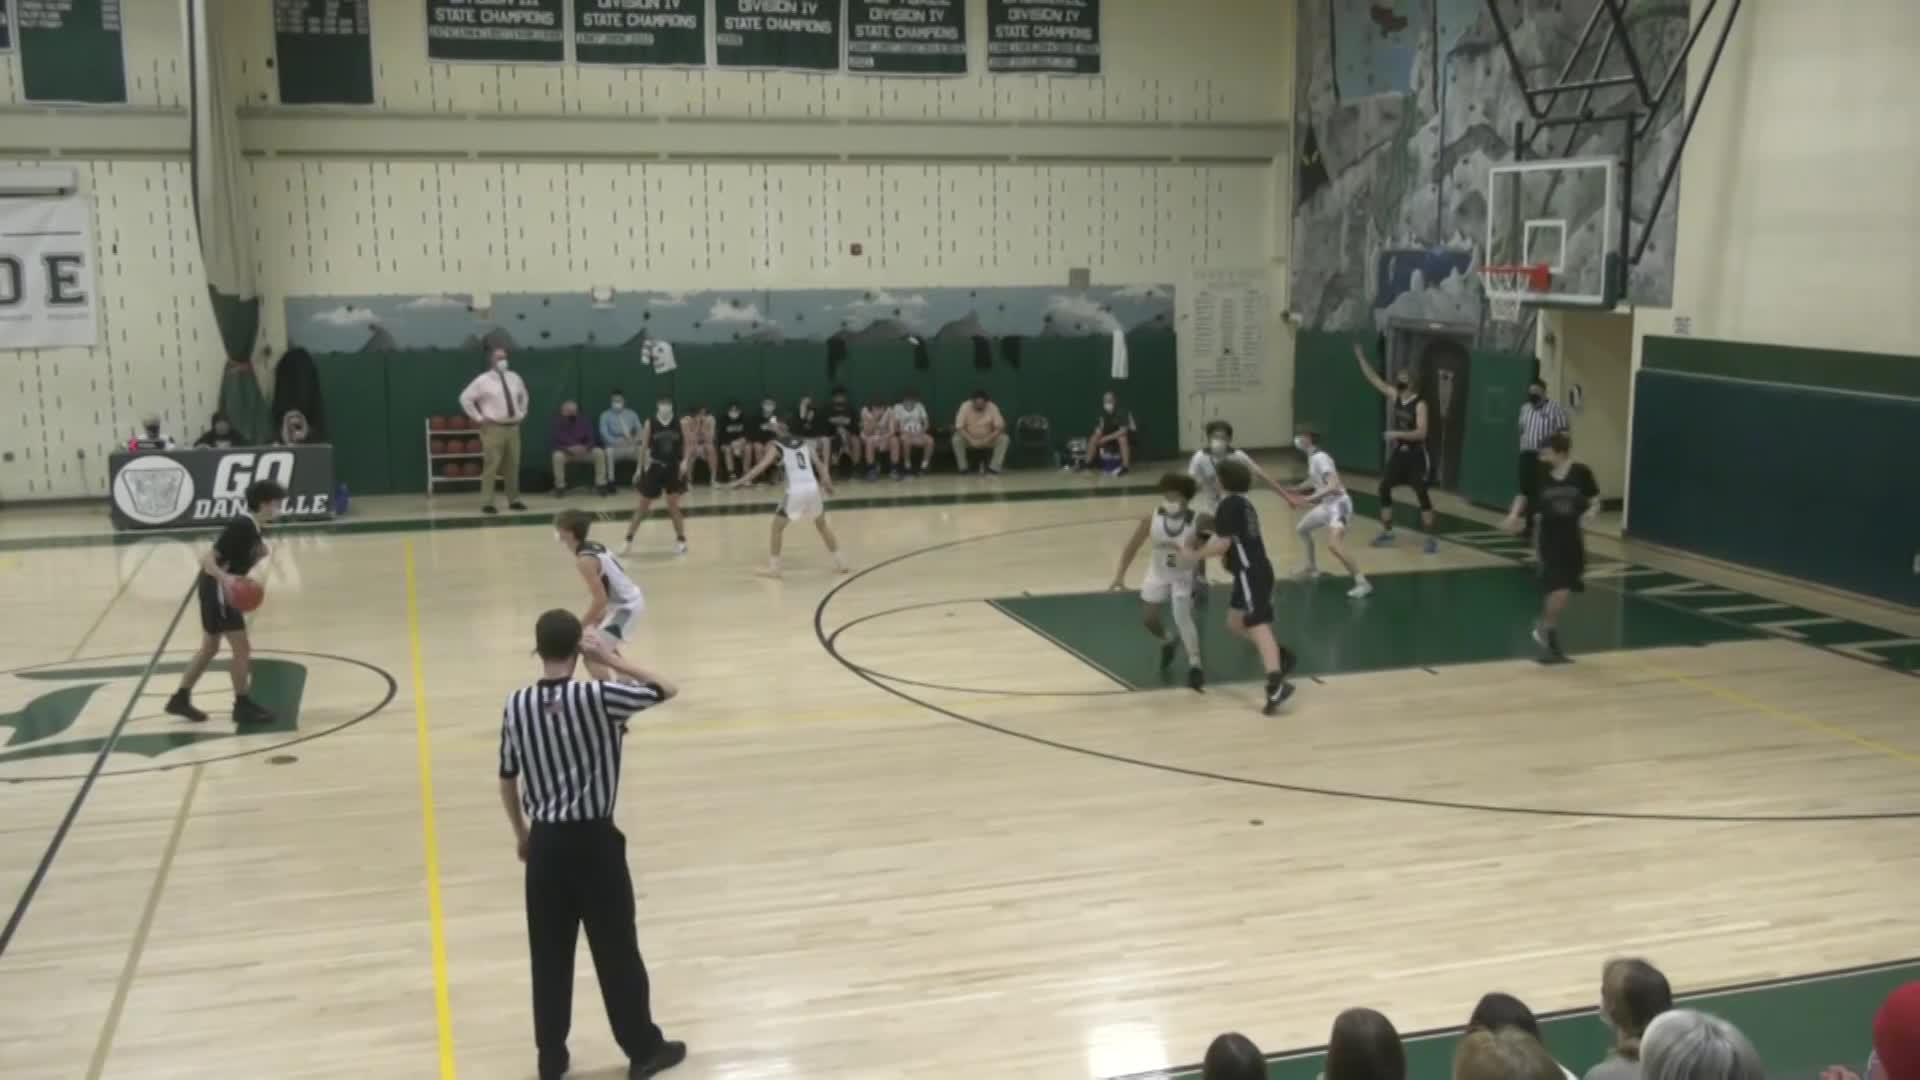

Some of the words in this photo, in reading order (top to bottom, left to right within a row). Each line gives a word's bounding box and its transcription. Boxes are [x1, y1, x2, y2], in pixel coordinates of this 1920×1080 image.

[738, 0, 798, 14] DIVISION
[801, 0, 819, 15] IV
[869, 7, 926, 23] DIVISION
[928, 8, 945, 22] IV
[1008, 7, 1063, 22] DIVISION
[1065, 9, 1081, 22] IV
[435, 7, 475, 22] STATE
[480, 9, 555, 26] CHAMPIONS
[583, 12, 624, 27] STATE
[626, 14, 697, 29] CHAMPIONS
[724, 16, 762, 30] STATE
[765, 17, 832, 34] CHAMPIONS
[855, 24, 891, 38] STATE
[894, 26, 959, 40] CHAMPIONS
[995, 24, 1029, 39] STATE
[1032, 25, 1092, 41] CHAMPIONS
[193, 494, 329, 520] DANLLE
